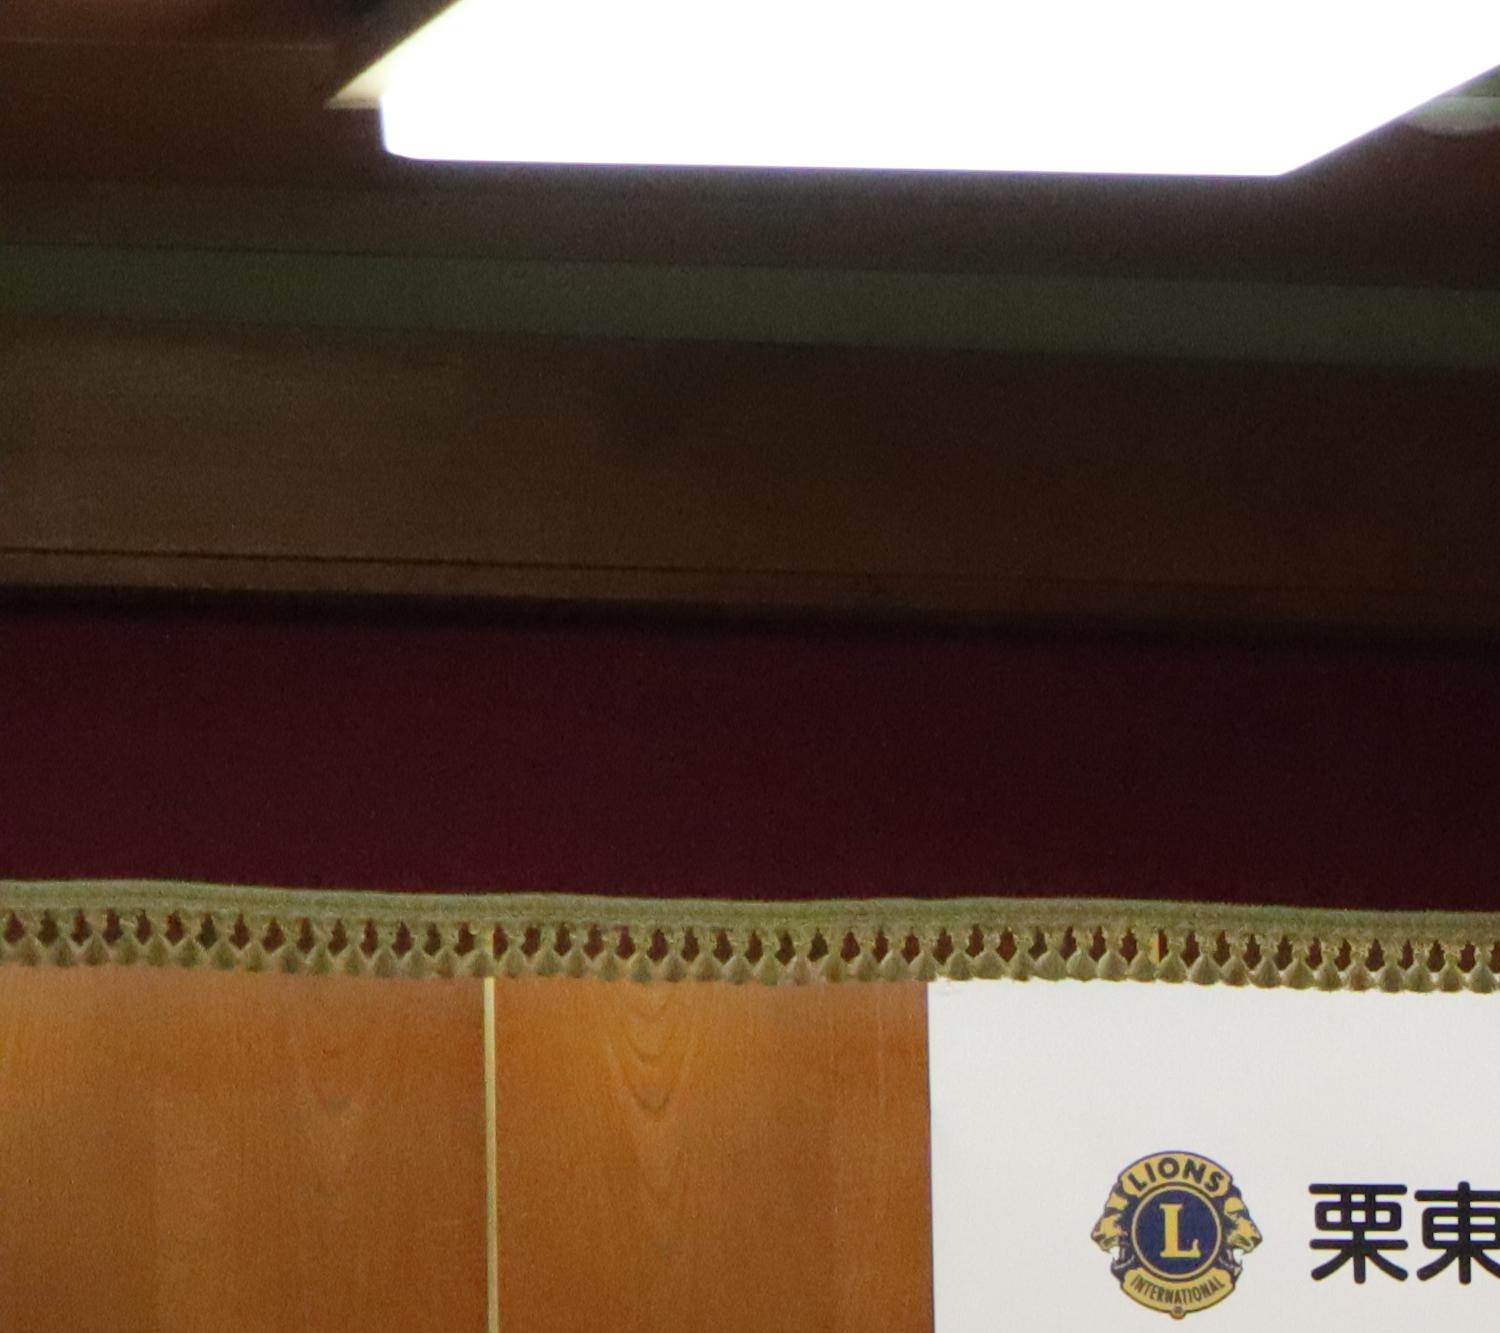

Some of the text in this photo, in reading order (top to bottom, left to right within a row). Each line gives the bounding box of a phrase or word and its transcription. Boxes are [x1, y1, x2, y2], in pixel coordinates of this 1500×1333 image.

[1127, 1156, 1225, 1193] LIONS
[1159, 1203, 1201, 1258] L
[1129, 1274, 1226, 1306] INTERNATIONAL
